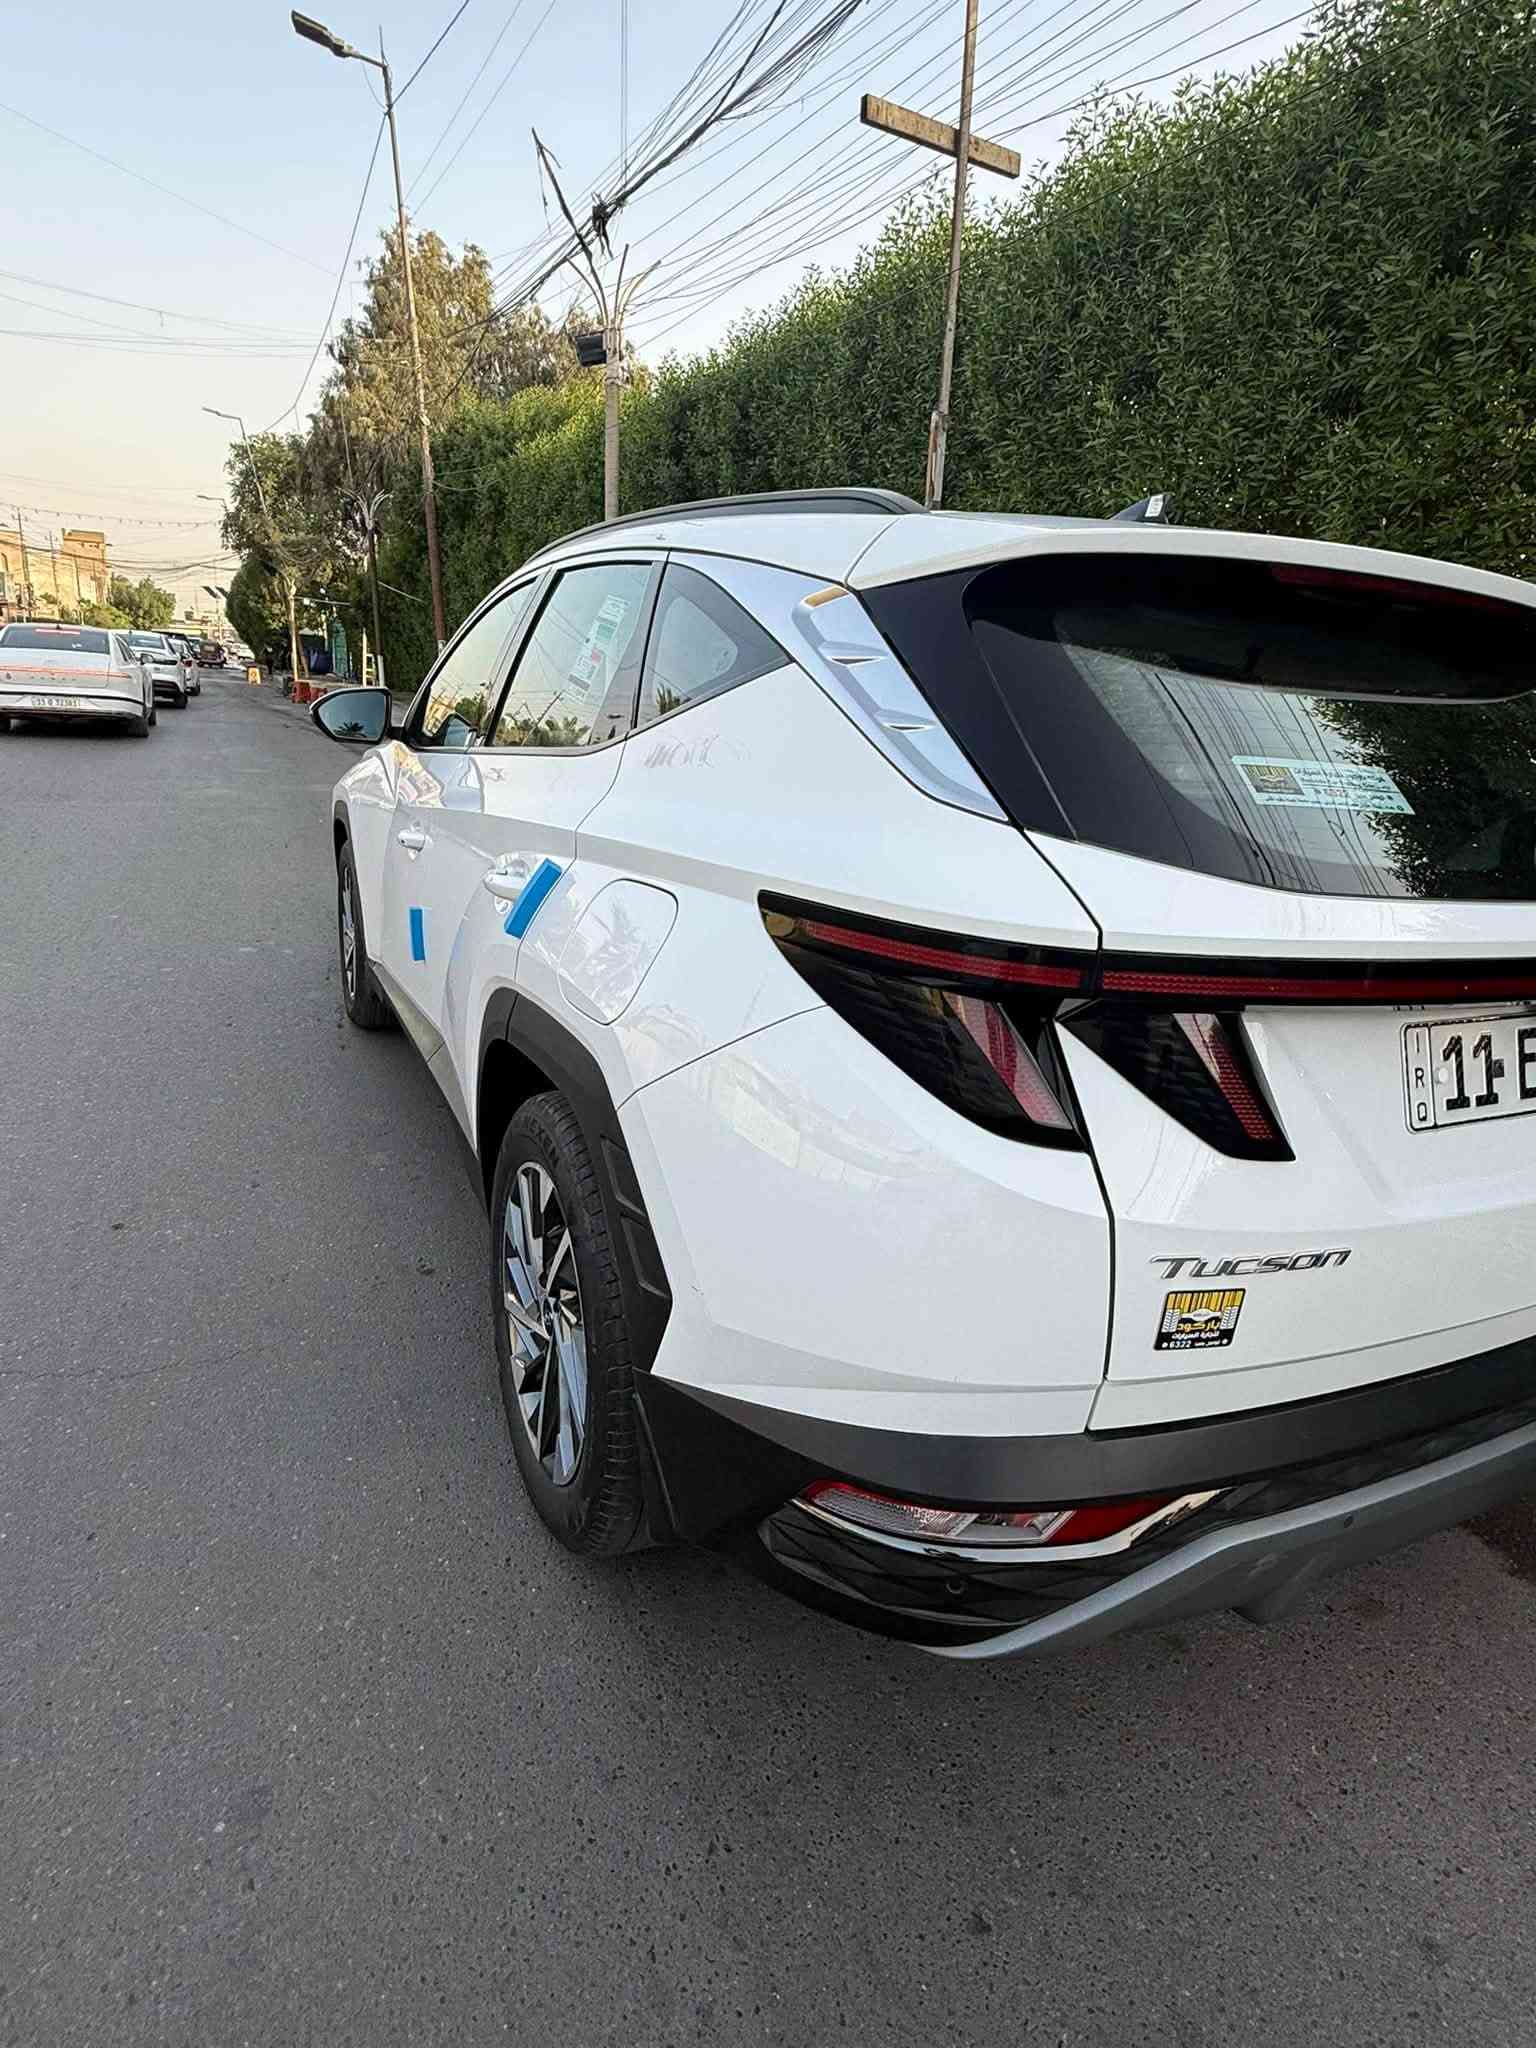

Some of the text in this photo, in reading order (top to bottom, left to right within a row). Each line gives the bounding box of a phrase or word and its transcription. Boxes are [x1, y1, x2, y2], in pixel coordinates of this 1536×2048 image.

[1414, 1031, 1428, 1122] IRQ
[1441, 1033, 1499, 1111] 11
[1176, 1320, 1220, 1333] باركود
